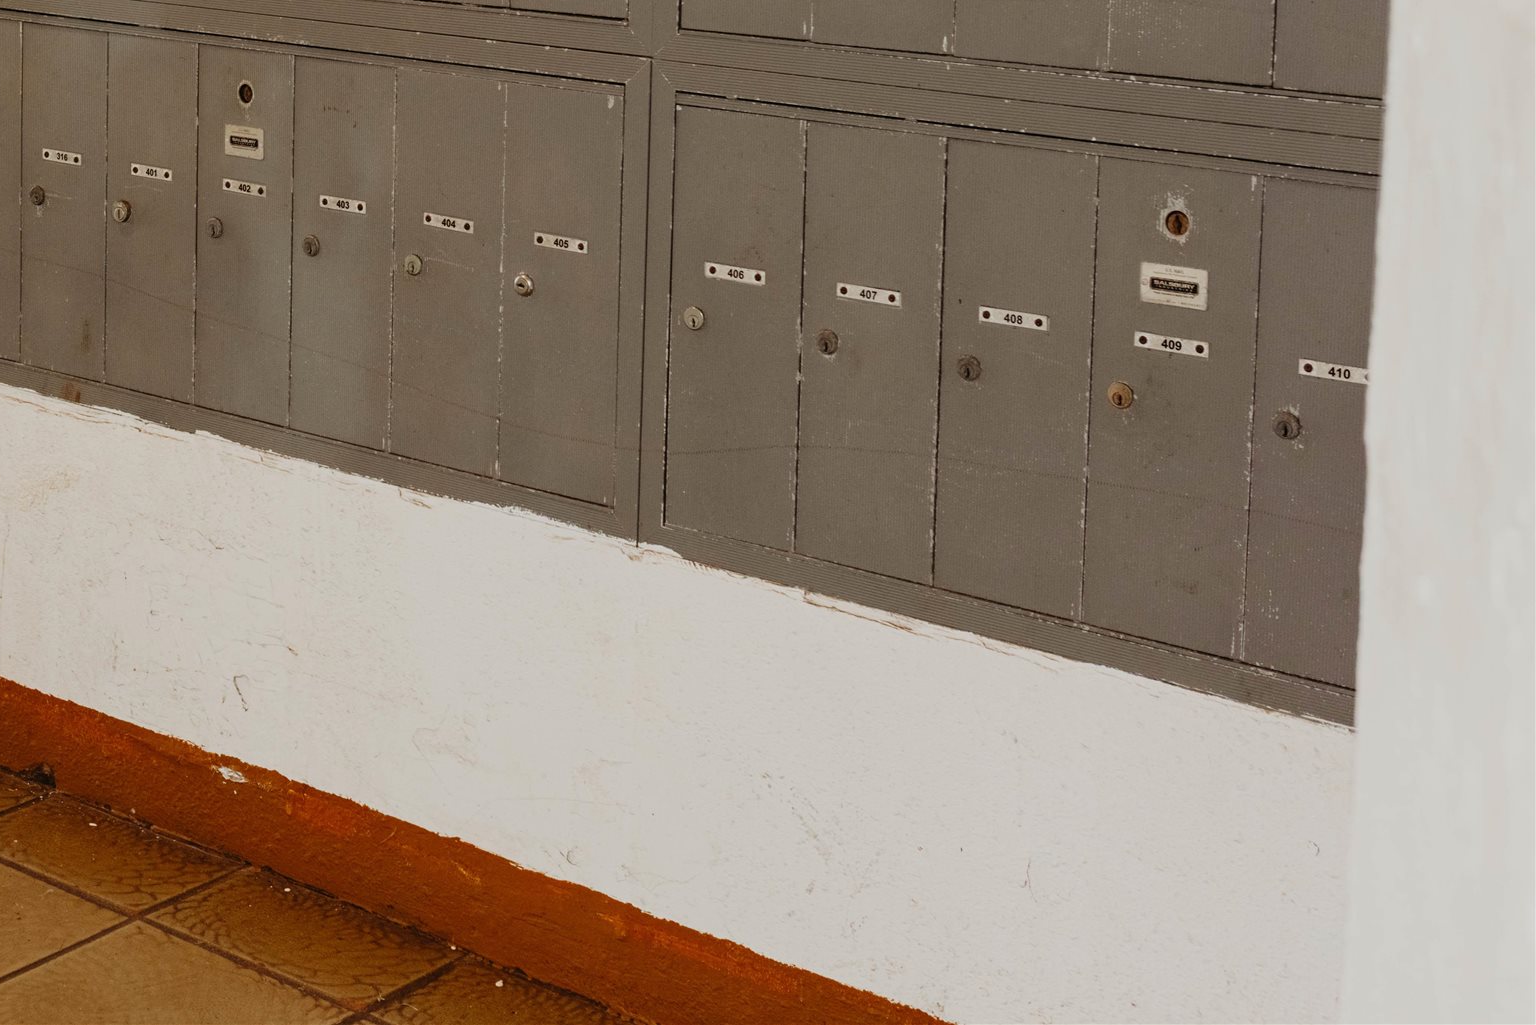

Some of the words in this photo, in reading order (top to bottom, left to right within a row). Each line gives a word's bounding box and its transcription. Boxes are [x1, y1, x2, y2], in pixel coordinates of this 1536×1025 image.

[56, 152, 68, 161] 316
[146, 168, 158, 177] 401
[238, 183, 251, 193] 402
[336, 200, 350, 209] 403
[441, 218, 456, 228] 404
[553, 238, 569, 249] 405
[727, 268, 744, 280] 406
[1153, 279, 1195, 290] SALSBURY
[859, 288, 878, 300] 407
[1003, 313, 1023, 325] 408
[1161, 338, 1182, 351] 409
[1328, 366, 1351, 379] 410
